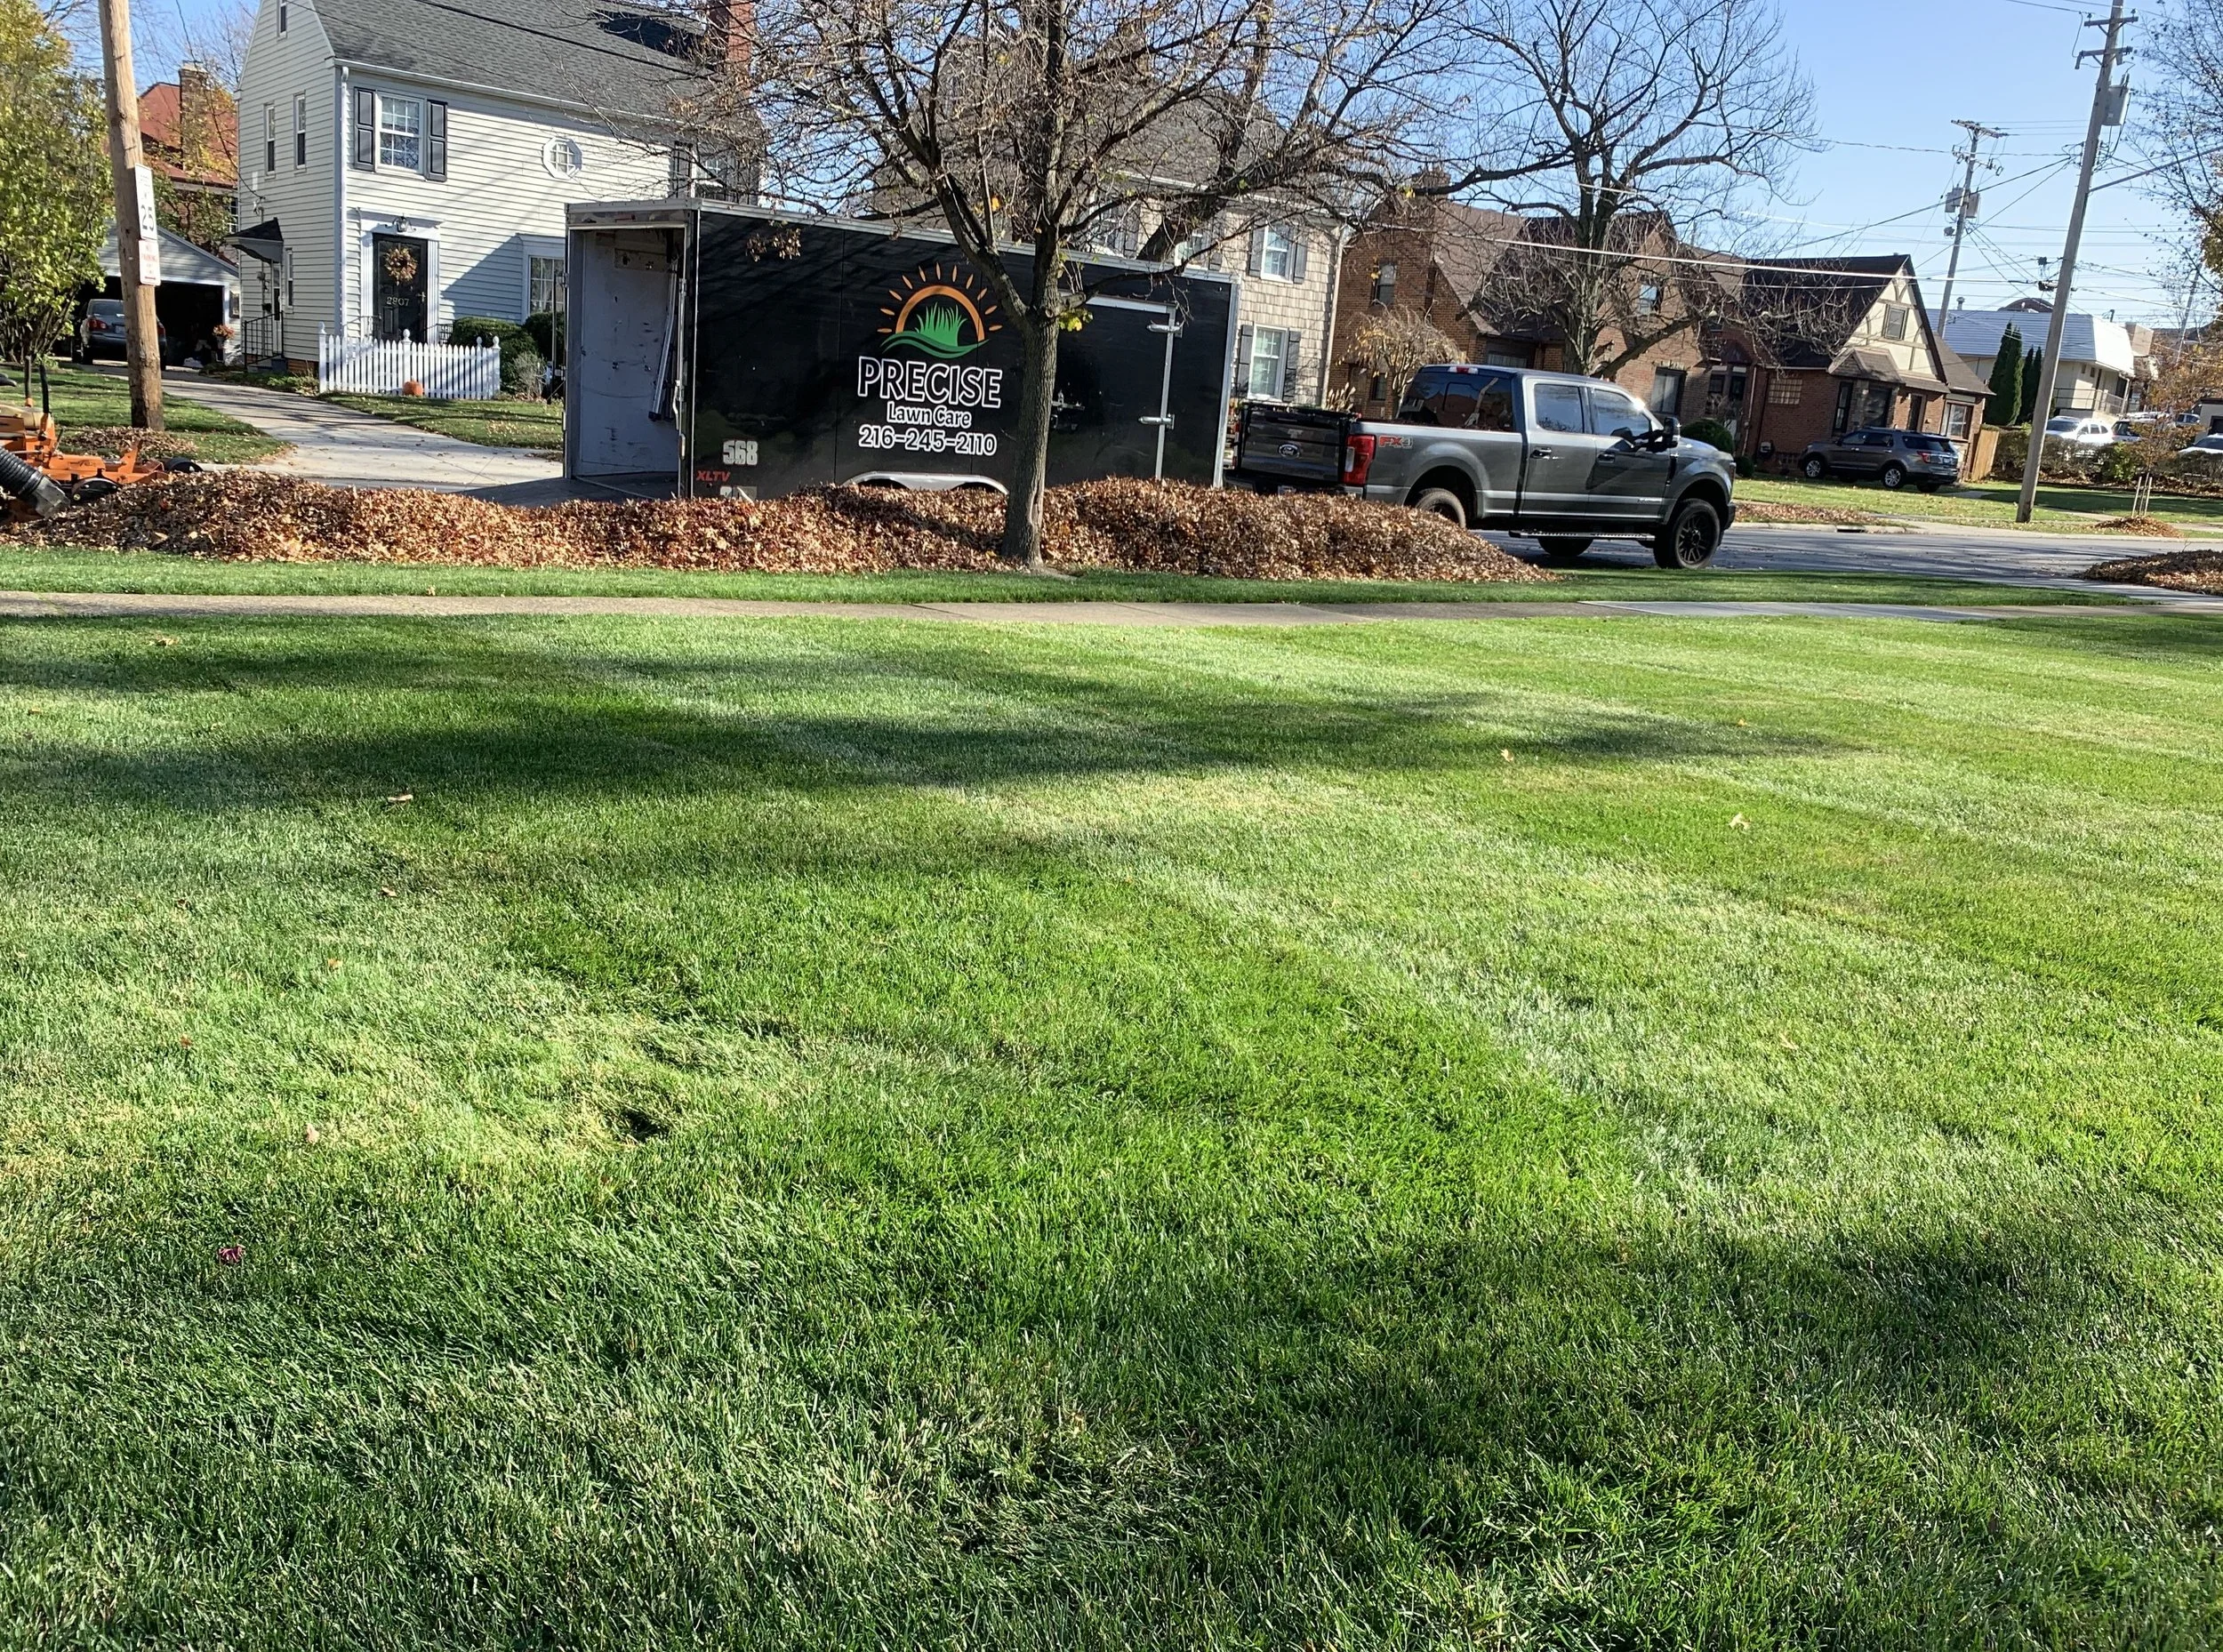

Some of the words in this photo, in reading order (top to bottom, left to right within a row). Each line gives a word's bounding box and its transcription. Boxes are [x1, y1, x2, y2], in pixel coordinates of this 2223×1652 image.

[140, 204, 155, 232] 25
[858, 356, 1002, 408] PRECISE
[887, 401, 932, 425] Lawn
[934, 405, 972, 429] Care
[723, 440, 758, 465] 568
[859, 424, 998, 456] 216-245-2110
[1378, 435, 1414, 449] FX4
[696, 470, 731, 482] XLTV
